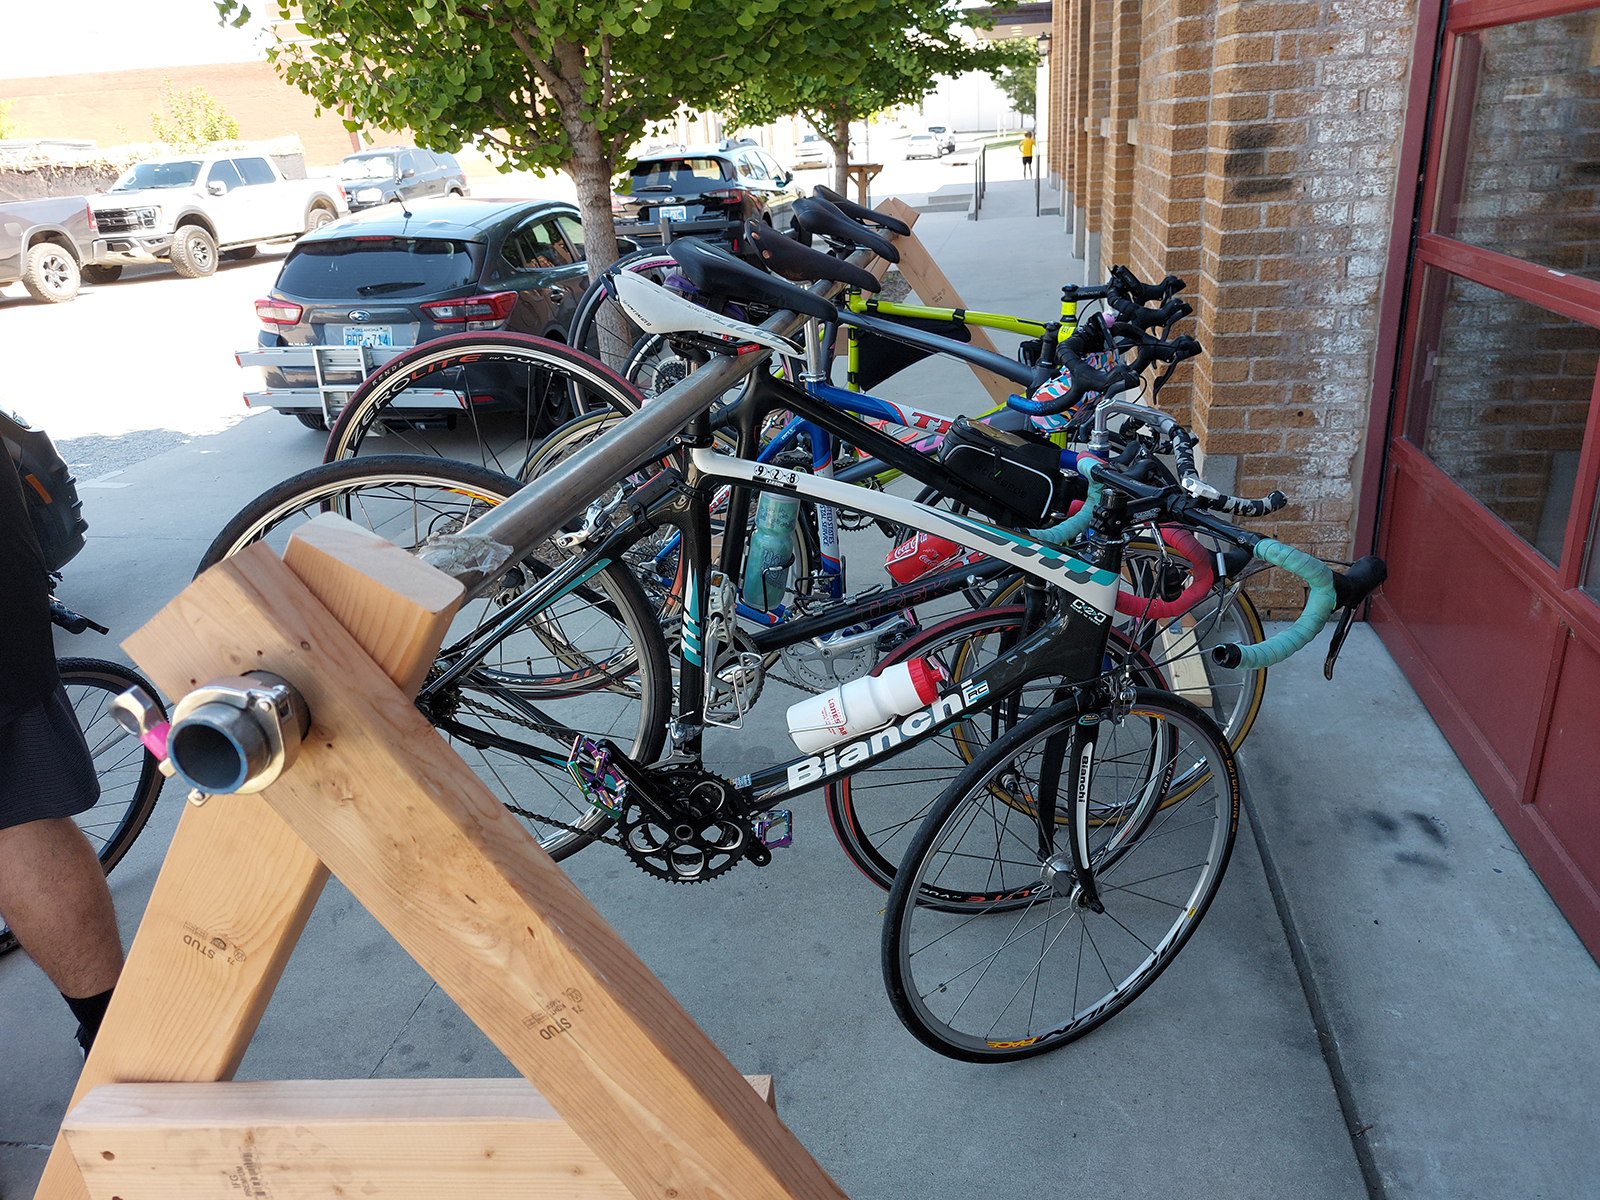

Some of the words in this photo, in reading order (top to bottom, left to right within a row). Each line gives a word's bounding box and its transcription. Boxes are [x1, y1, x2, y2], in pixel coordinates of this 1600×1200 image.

[371, 360, 404, 387] KENDA
[854, 577, 952, 620] TREK
[827, 697, 848, 736] LONESAR
[787, 678, 978, 791] Bianchi
[1078, 755, 1090, 803] Bianchi
[183, 934, 216, 960] STUD
[227, 956, 235, 966] 71
[571, 1004, 584, 1015] 71
[539, 1017, 573, 1041] STUD
[229, 1174, 242, 1189] IFG
